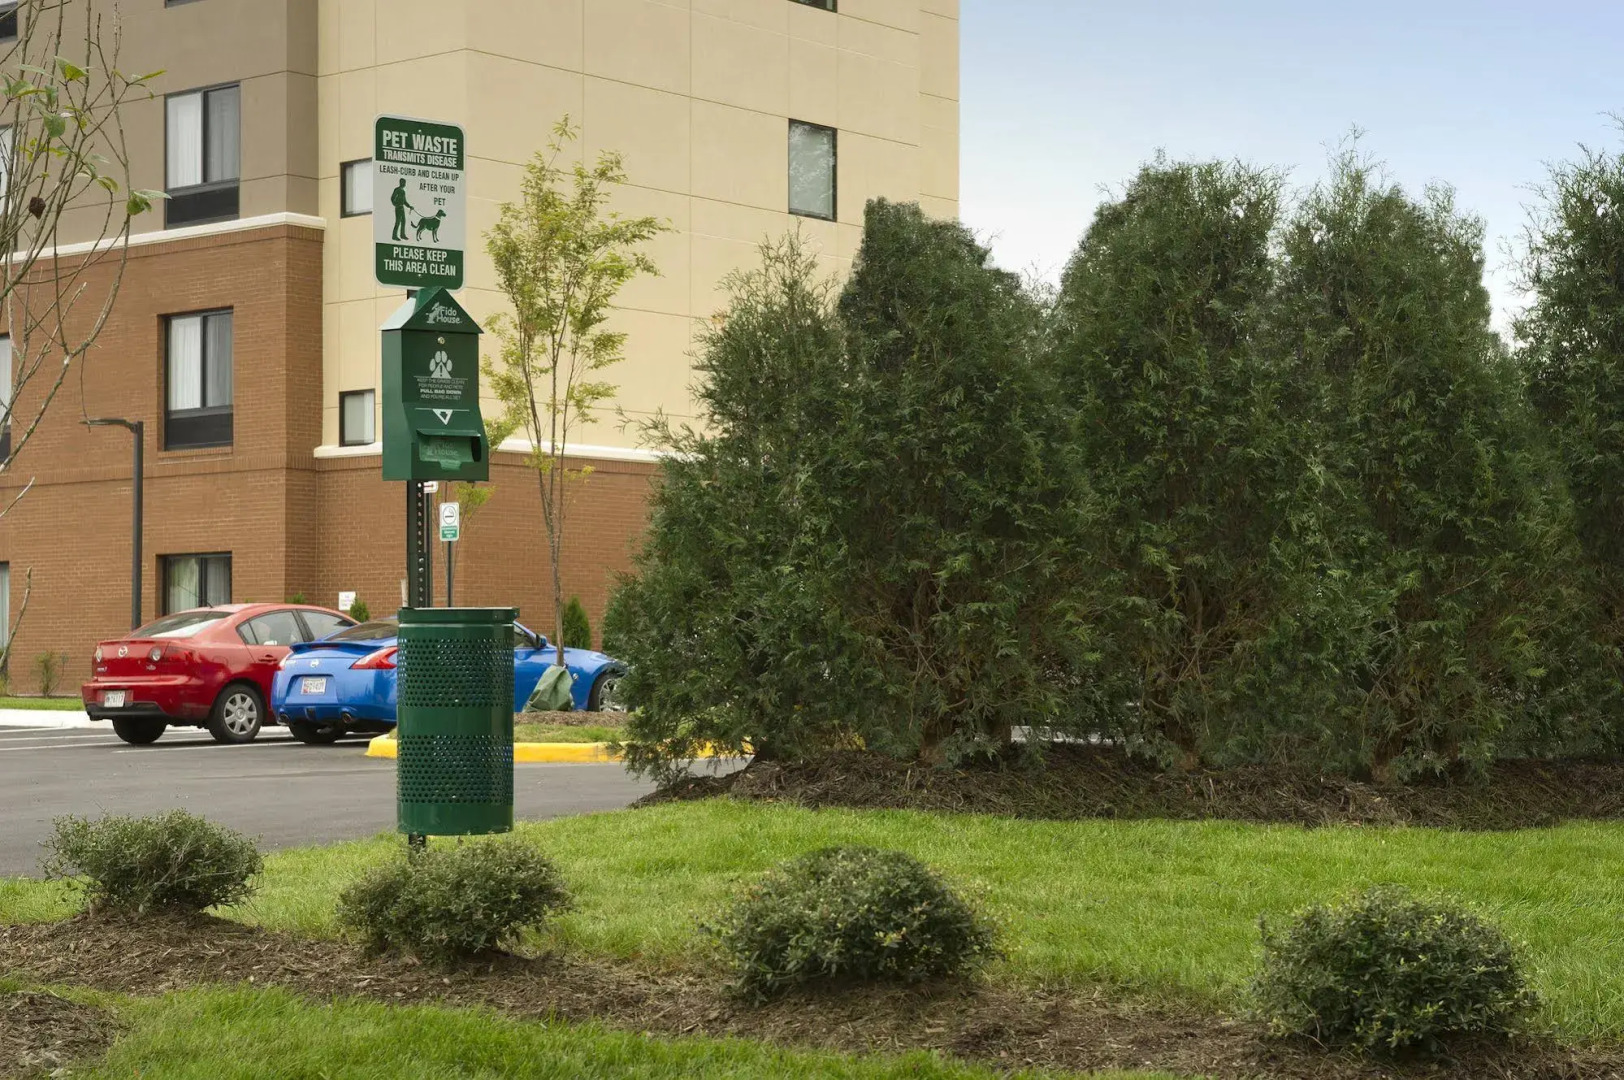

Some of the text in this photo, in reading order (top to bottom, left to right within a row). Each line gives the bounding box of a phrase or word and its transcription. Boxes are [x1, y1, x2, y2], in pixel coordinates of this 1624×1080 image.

[382, 130, 458, 154] PET WASTE
[382, 150, 457, 168] TRANSMITS DISEASE
[380, 165, 416, 176] LEASH-CURB
[418, 170, 429, 178] AND
[431, 171, 450, 180] CLEAN
[419, 183, 455, 194] AFTER YOUR
[434, 198, 446, 206] PET
[394, 247, 447, 262] PLEASE KEEP
[384, 259, 456, 276] THIS AREA CLEAN
[439, 306, 457, 316] Fido
[437, 314, 460, 324] House
